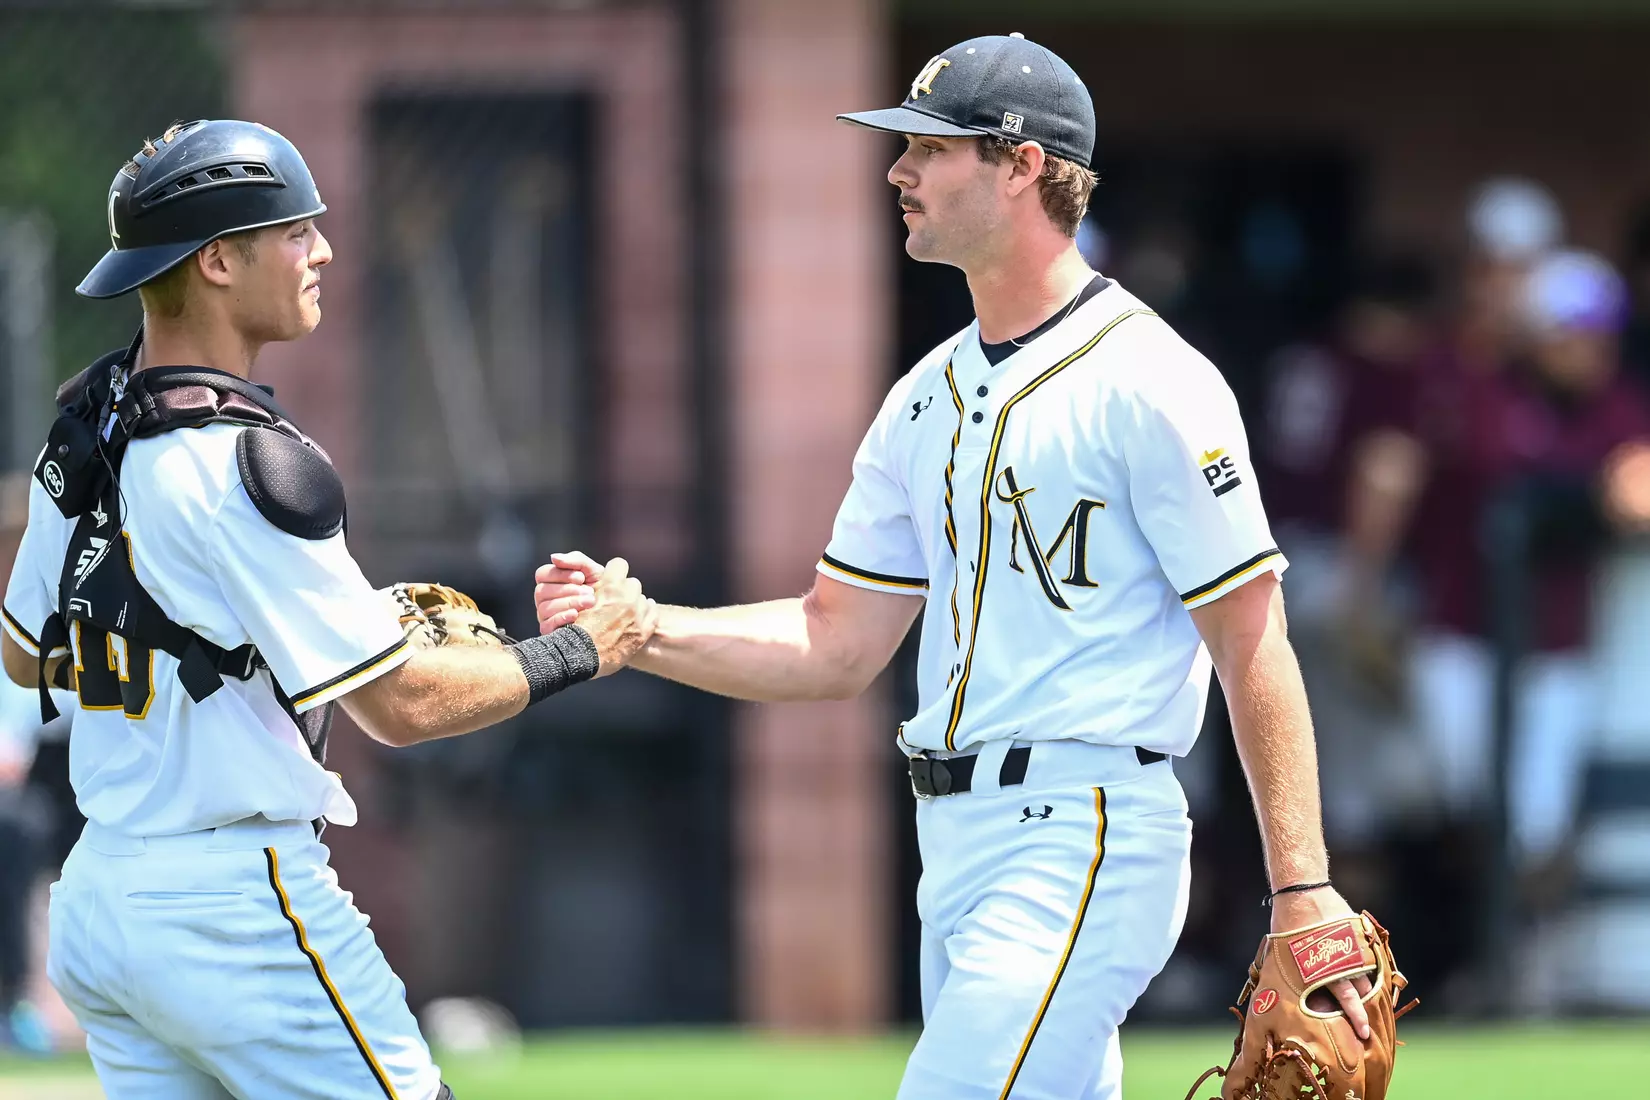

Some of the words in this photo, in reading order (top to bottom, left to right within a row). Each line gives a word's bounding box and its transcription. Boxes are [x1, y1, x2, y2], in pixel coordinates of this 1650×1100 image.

[1202, 456, 1237, 487] PS
[1304, 937, 1353, 969] Rawlings
[1256, 990, 1276, 1014] R
